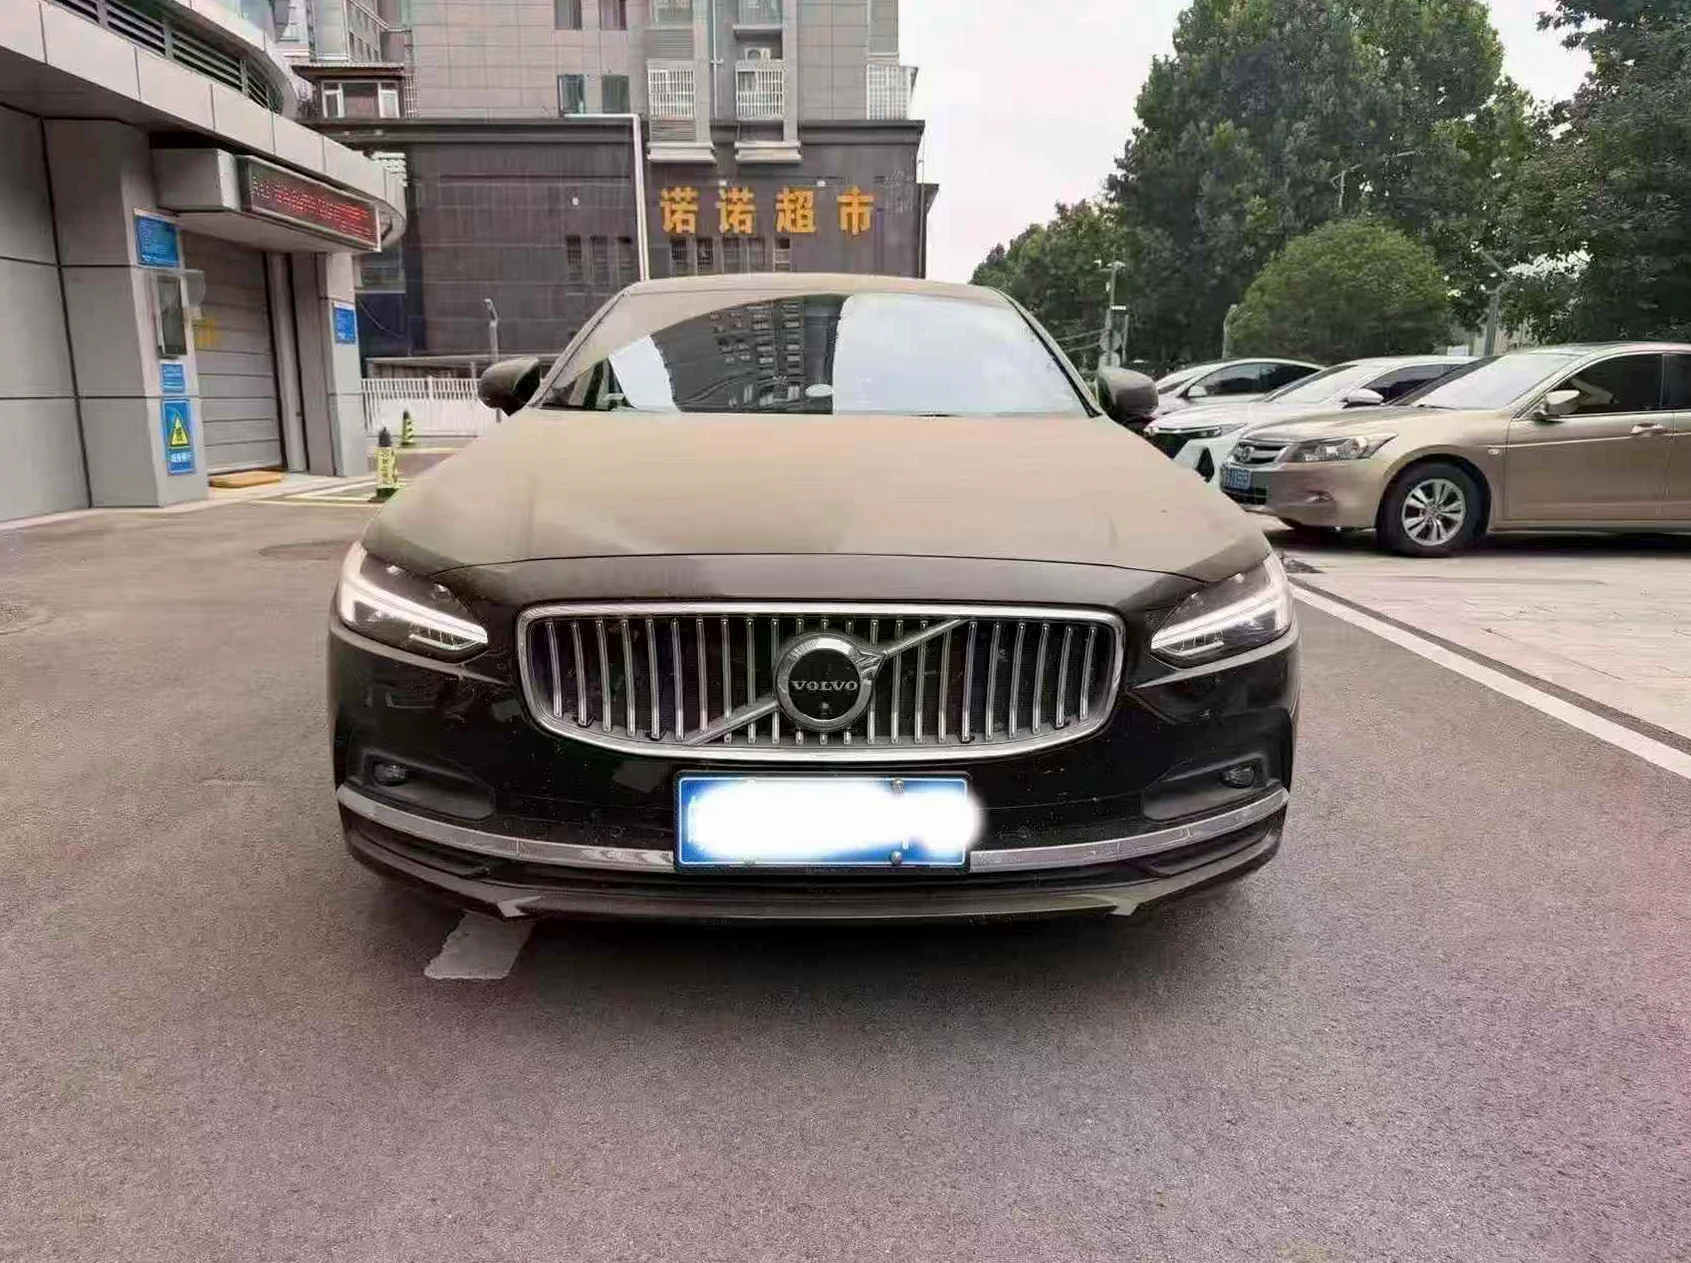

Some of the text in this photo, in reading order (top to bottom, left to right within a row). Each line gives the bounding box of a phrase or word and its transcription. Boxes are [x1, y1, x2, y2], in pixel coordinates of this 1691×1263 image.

[660, 185, 875, 235] 诺诺超市
[791, 680, 858, 691] VOLVO
